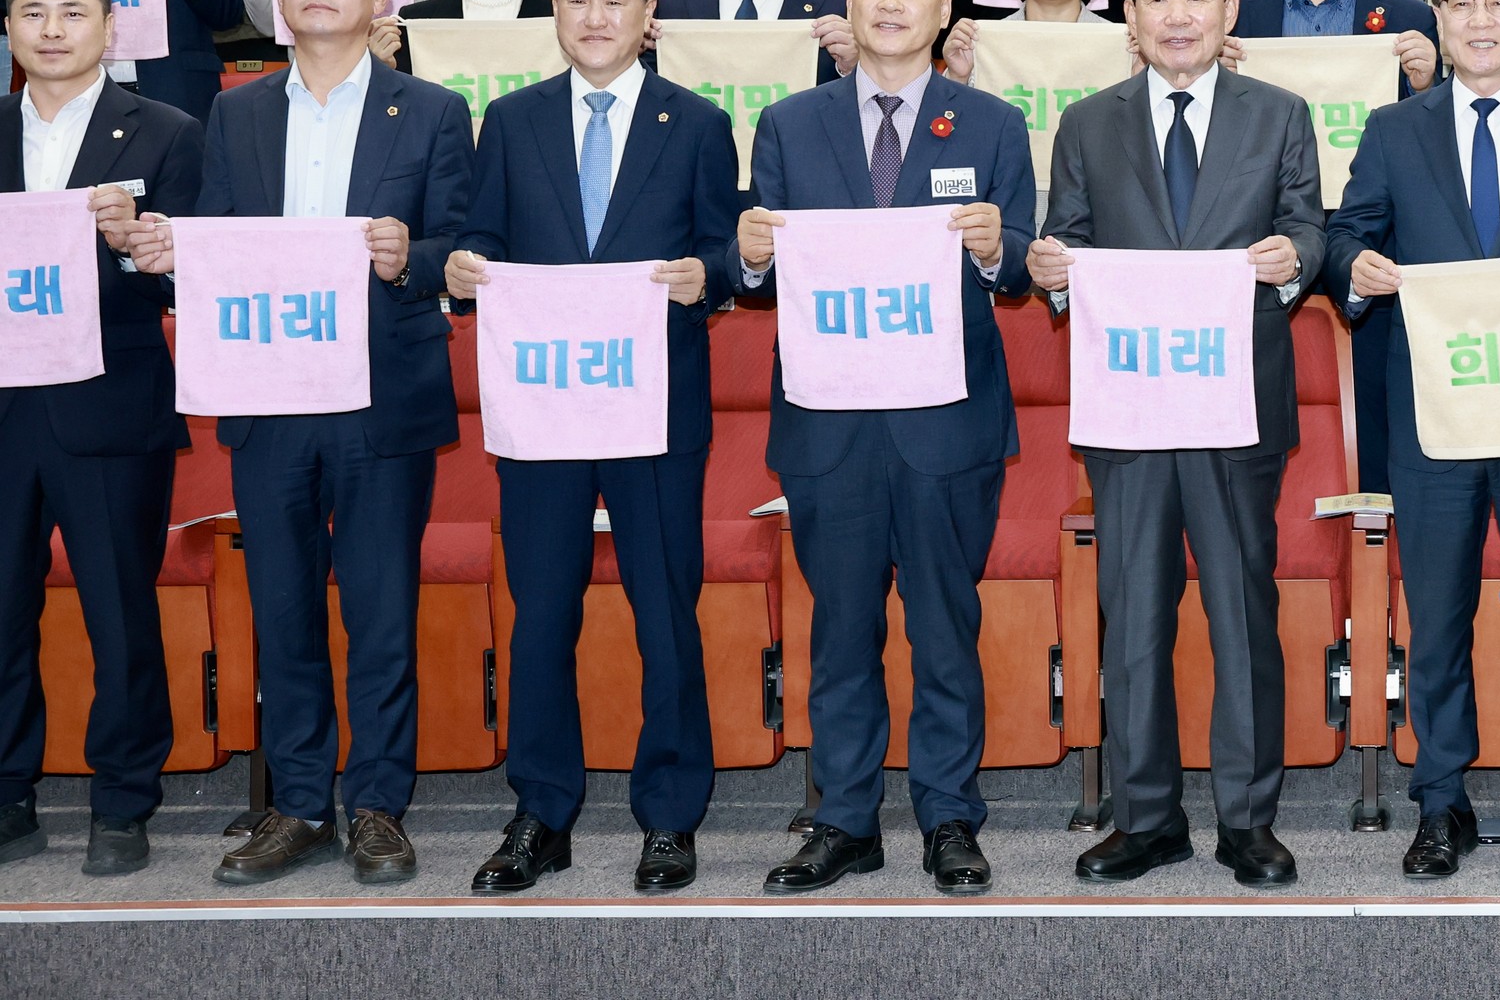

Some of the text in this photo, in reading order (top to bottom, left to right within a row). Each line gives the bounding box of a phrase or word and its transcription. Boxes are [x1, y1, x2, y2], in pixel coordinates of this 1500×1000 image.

[1305, 101, 1372, 151] 망
[934, 178, 973, 195] 이광일
[2, 263, 66, 318] 래
[215, 289, 339, 345] 미래
[811, 282, 936, 341] 미래
[513, 336, 636, 391] 미래
[1105, 325, 1227, 379] 미래
